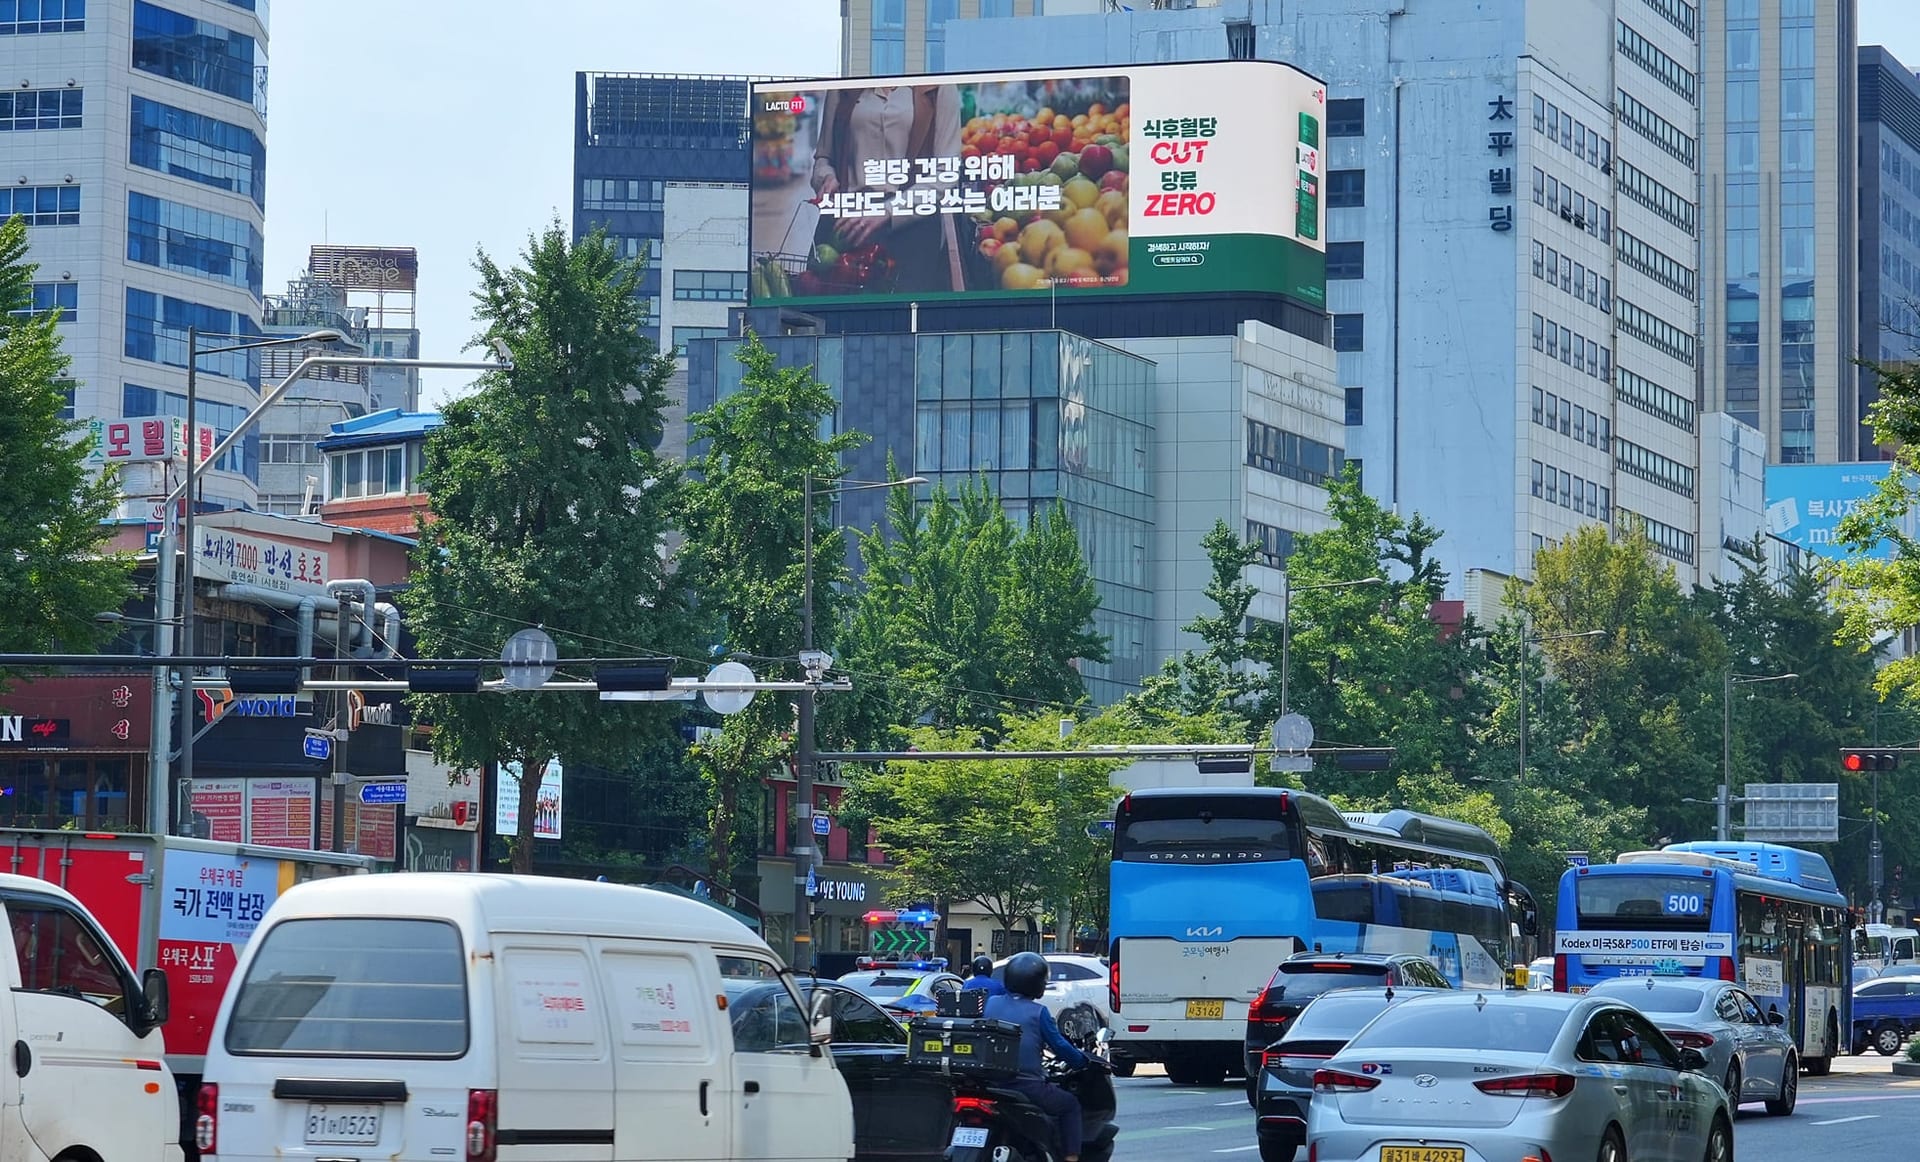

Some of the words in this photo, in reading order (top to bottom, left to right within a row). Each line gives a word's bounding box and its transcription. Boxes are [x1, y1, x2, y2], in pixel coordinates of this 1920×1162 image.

[766, 101, 789, 111] LACTO
[791, 101, 803, 110] FIT
[1142, 117, 1217, 139] 식후혈당
[1150, 141, 1208, 165] CUT
[1487, 94, 1514, 232] 太平빌딩
[863, 158, 911, 186] 혈당
[914, 156, 962, 184] 건강
[964, 154, 1015, 182] 위해
[1160, 170, 1198, 191] 당류
[817, 191, 886, 219] 식단도
[890, 189, 939, 217] 신경
[939, 188, 987, 214] 쓰는
[990, 184, 1061, 212] 여러분
[1143, 192, 1216, 217] ZERO
[107, 420, 165, 458] 모텔
[203, 533, 235, 567] 노가리
[237, 696, 296, 717] world
[364, 703, 393, 723] world
[31, 720, 57, 737] cafe
[424, 849, 453, 872] world
[199, 867, 225, 886] 우체국
[226, 869, 243, 888] 예금
[836, 881, 865, 901] YOUNG
[173, 887, 202, 917] 국가
[205, 890, 234, 919] 전액
[237, 892, 265, 921] 보장
[1668, 895, 1699, 912] 500
[1183, 946, 1230, 957] 굿모닝여행사
[1561, 938, 1591, 949] Kodex
[1592, 937, 1650, 951] 미국S&P500
[1651, 939, 1678, 951] ETF에
[1680, 940, 1705, 951] 탑승!
[161, 948, 189, 966] 우체국
[189, 945, 214, 970] 소포
[1424, 1150, 1459, 1162] 4293
